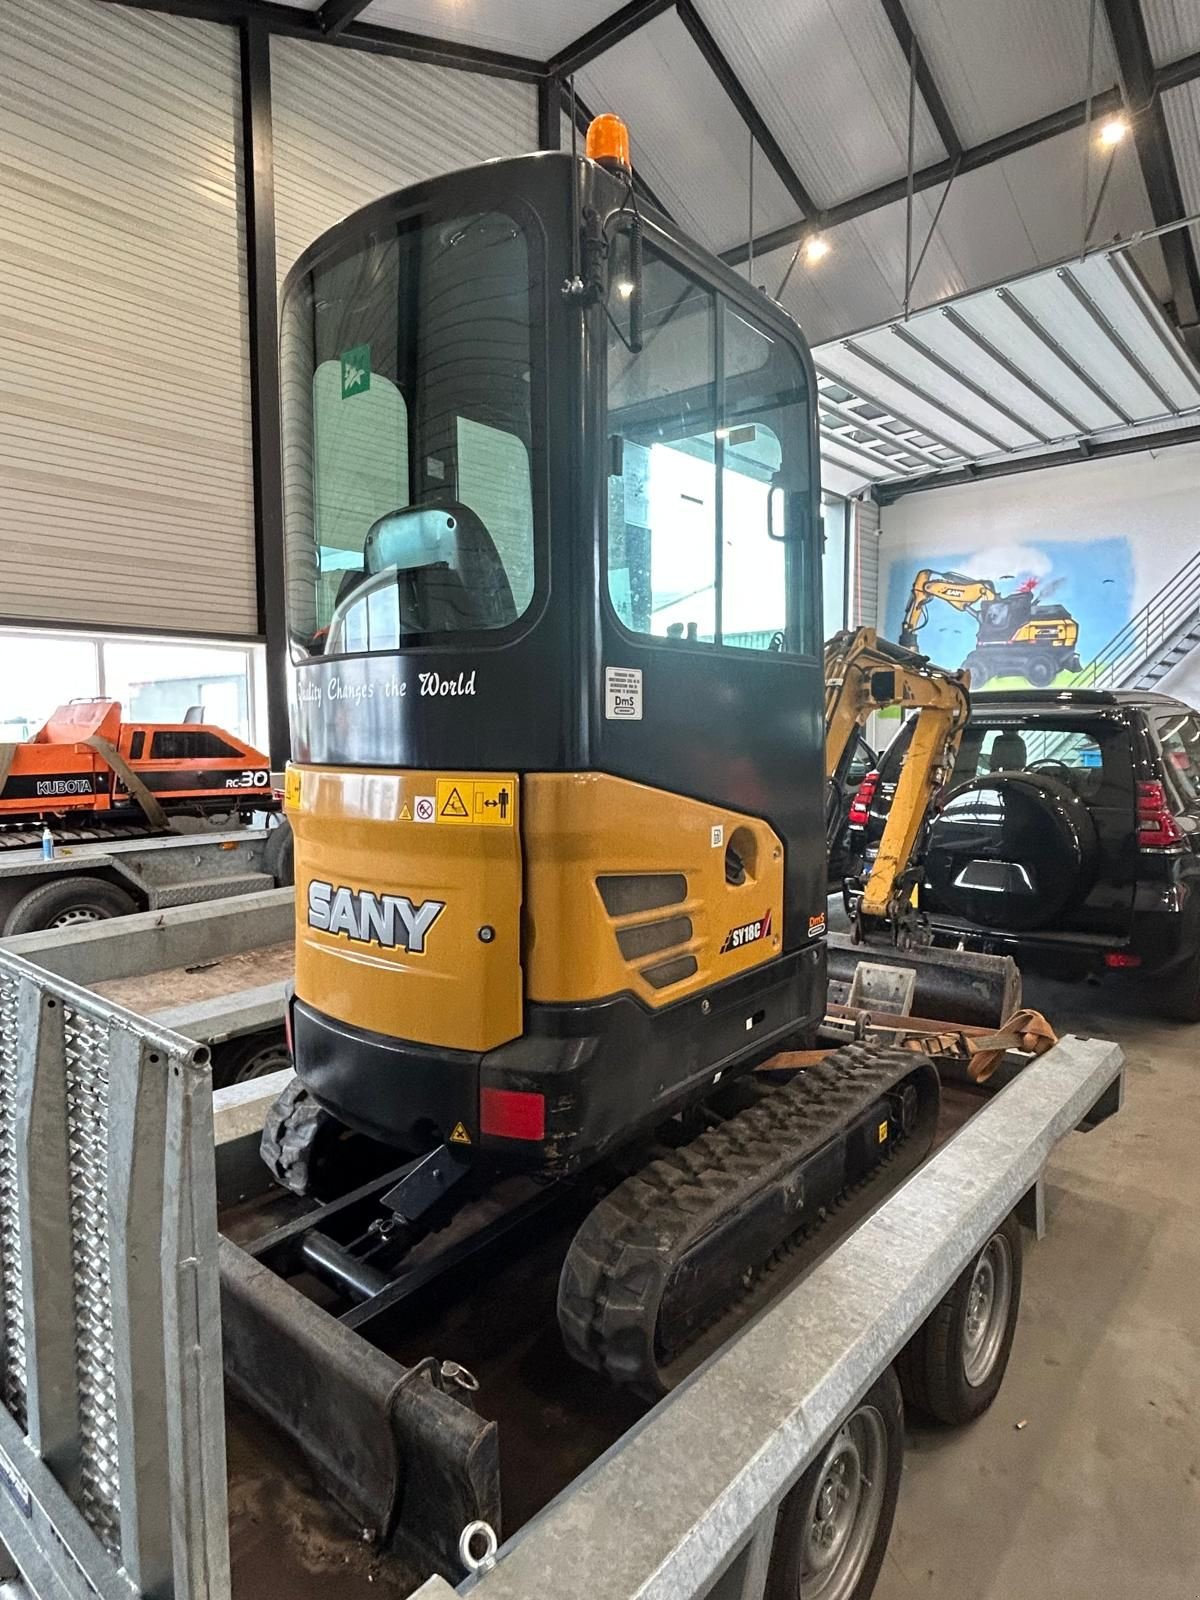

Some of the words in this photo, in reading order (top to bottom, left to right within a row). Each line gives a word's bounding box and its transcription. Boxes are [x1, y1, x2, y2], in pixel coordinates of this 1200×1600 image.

[327, 677, 375, 706] Changes
[385, 674, 407, 697] the
[418, 670, 477, 697] World
[615, 695, 634, 706] DmS
[36, 779, 93, 795] KUBOTA
[225, 770, 268, 788] RC-30
[308, 878, 446, 954] SANY
[732, 922, 761, 947] SY18C
